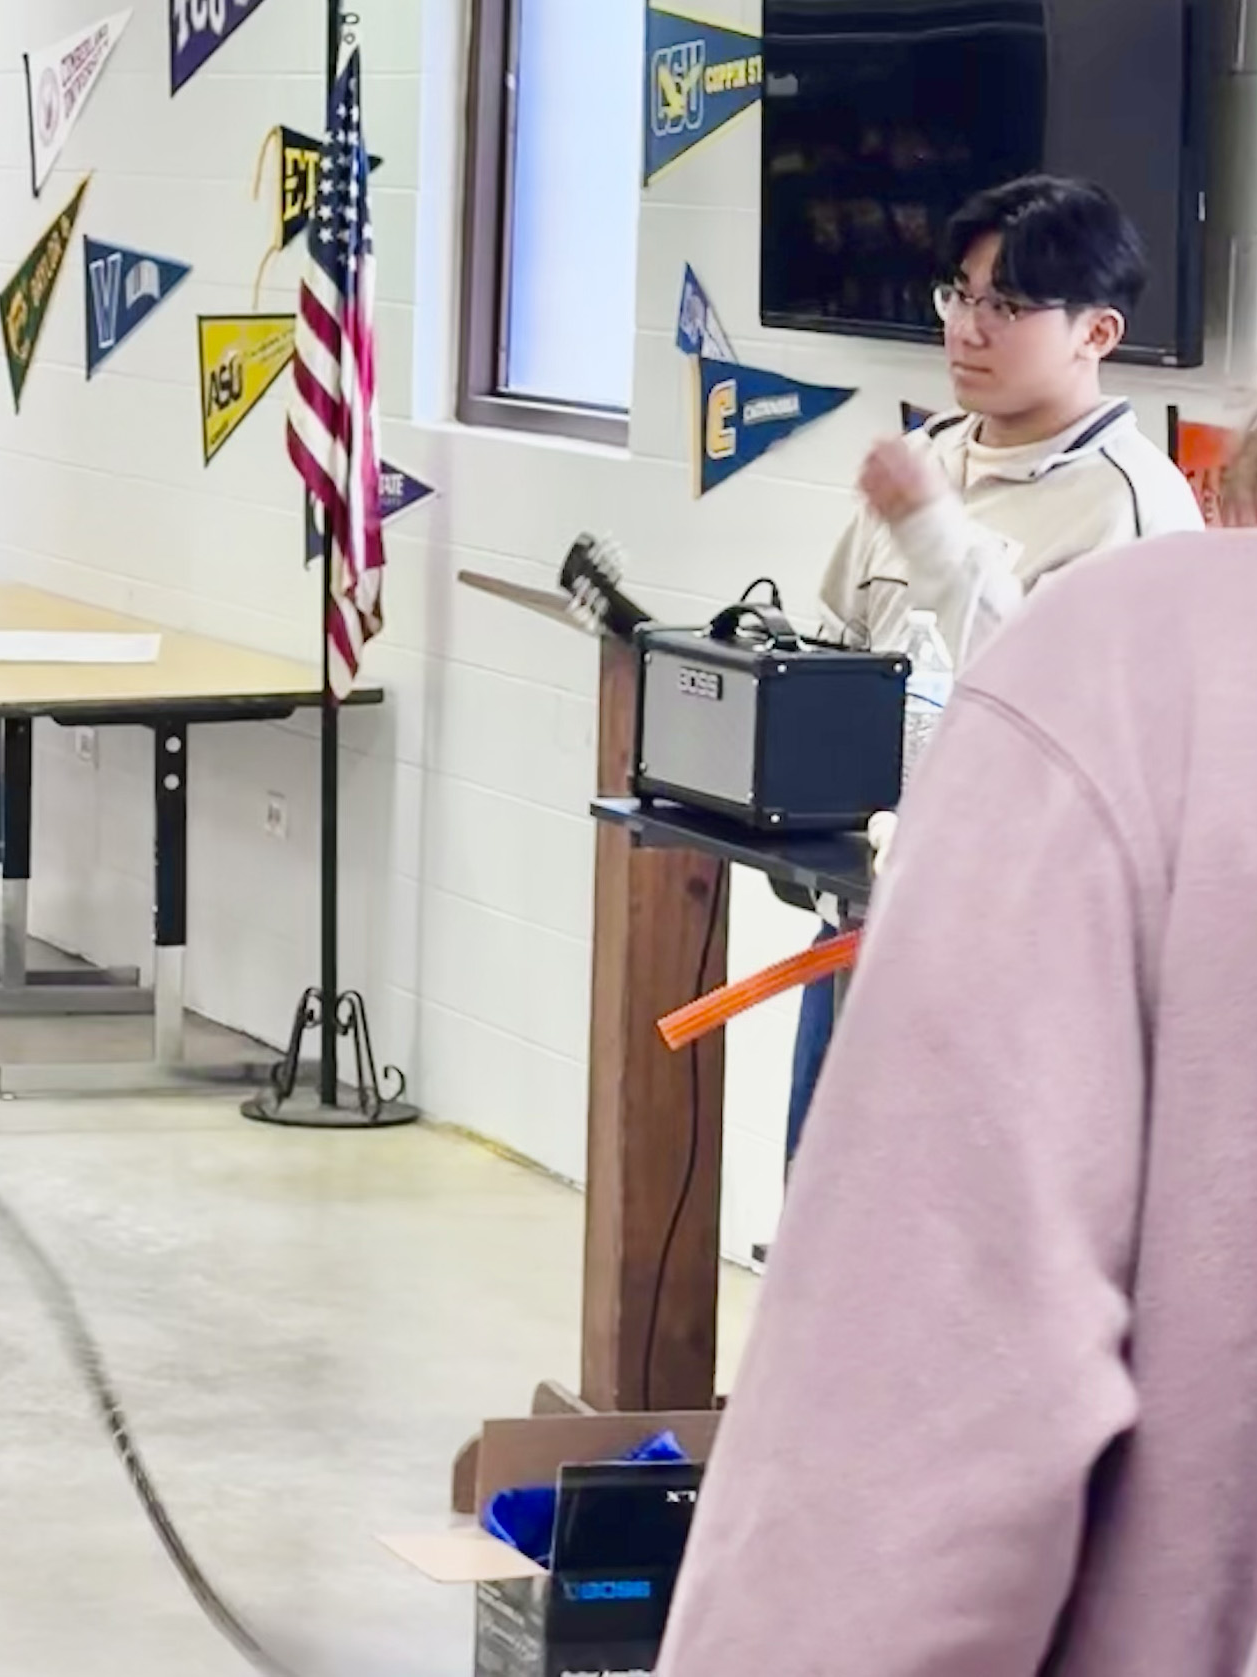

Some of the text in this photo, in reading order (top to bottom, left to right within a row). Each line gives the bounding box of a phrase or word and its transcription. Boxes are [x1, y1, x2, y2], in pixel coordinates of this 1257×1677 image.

[283, 147, 321, 222] ET
[678, 666, 719, 700] BOSS
[580, 1580, 651, 1600] BOSS
